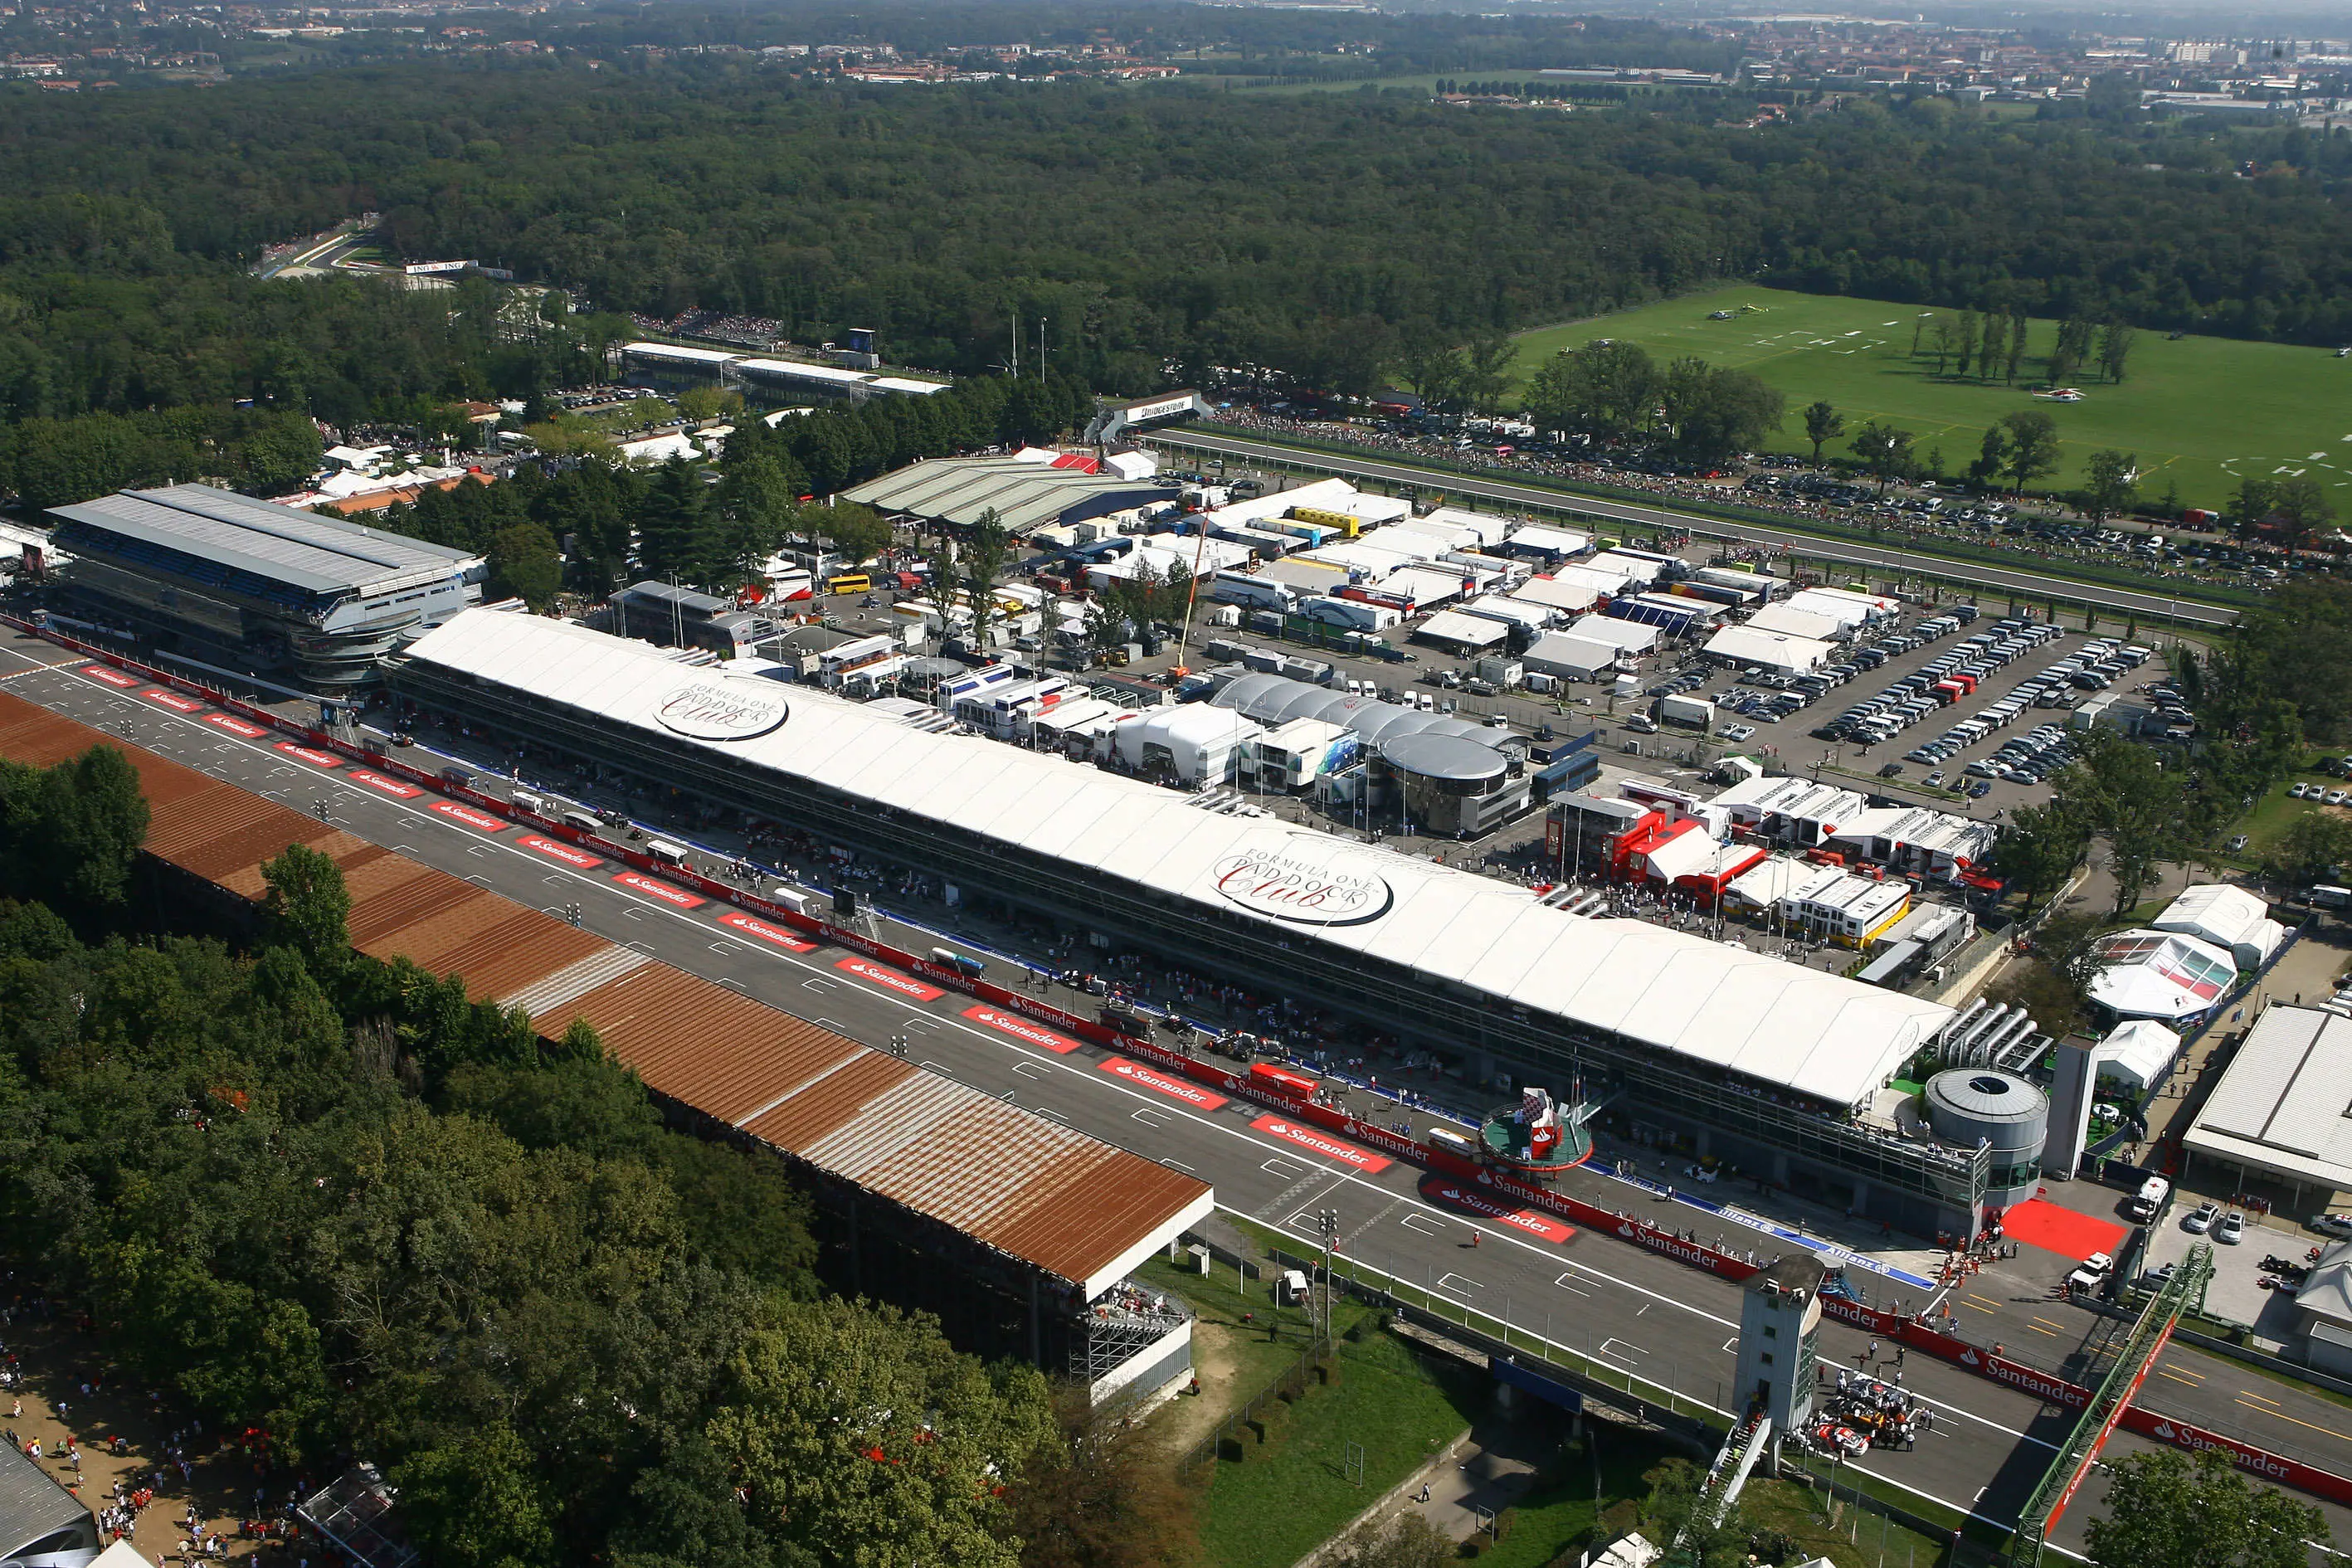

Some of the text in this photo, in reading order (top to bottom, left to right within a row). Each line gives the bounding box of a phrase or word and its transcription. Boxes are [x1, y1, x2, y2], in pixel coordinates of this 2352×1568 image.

[1142, 402, 1185, 416] BRIDGESTONE
[661, 694, 739, 725] Club
[677, 690, 765, 723] PADDOCK
[689, 683, 777, 712] FORMULA ONE
[294, 746, 332, 765] Santander
[334, 741, 365, 761] Santander
[370, 776, 410, 796] Santander
[390, 763, 425, 784] Santander
[450, 785, 486, 807] Santander
[451, 807, 495, 828] Santander
[517, 809, 553, 832] Santander
[539, 842, 588, 864] Santander
[586, 836, 625, 859] Santander
[660, 864, 703, 889] Santander
[1232, 858, 1363, 905] PADDOCK
[1244, 848, 1375, 892] FORMULA ONE
[638, 880, 690, 903] Santander
[1218, 863, 1334, 908] Club
[740, 894, 786, 921] Santander
[745, 922, 803, 947] Santander
[830, 928, 878, 956] Santander
[863, 967, 928, 996] Santander
[923, 963, 976, 993] Santander
[1020, 999, 1078, 1030] Santander
[992, 1016, 1062, 1048] Santander
[1126, 1038, 1186, 1072] Santander
[1132, 1070, 1208, 1103] Santander
[1238, 1079, 1303, 1114] Santander
[1286, 1129, 1369, 1166] Santander
[1358, 1125, 1429, 1161] Santander
[1494, 1175, 1570, 1215] Santander
[1460, 1195, 1552, 1234] Santander
[1713, 1208, 1761, 1228] Allianz
[1637, 1228, 1718, 1269] Santander
[1826, 1248, 1874, 1269] Allianz
[1822, 1296, 1879, 1330] tander
[1986, 1359, 2086, 1408] Santander
